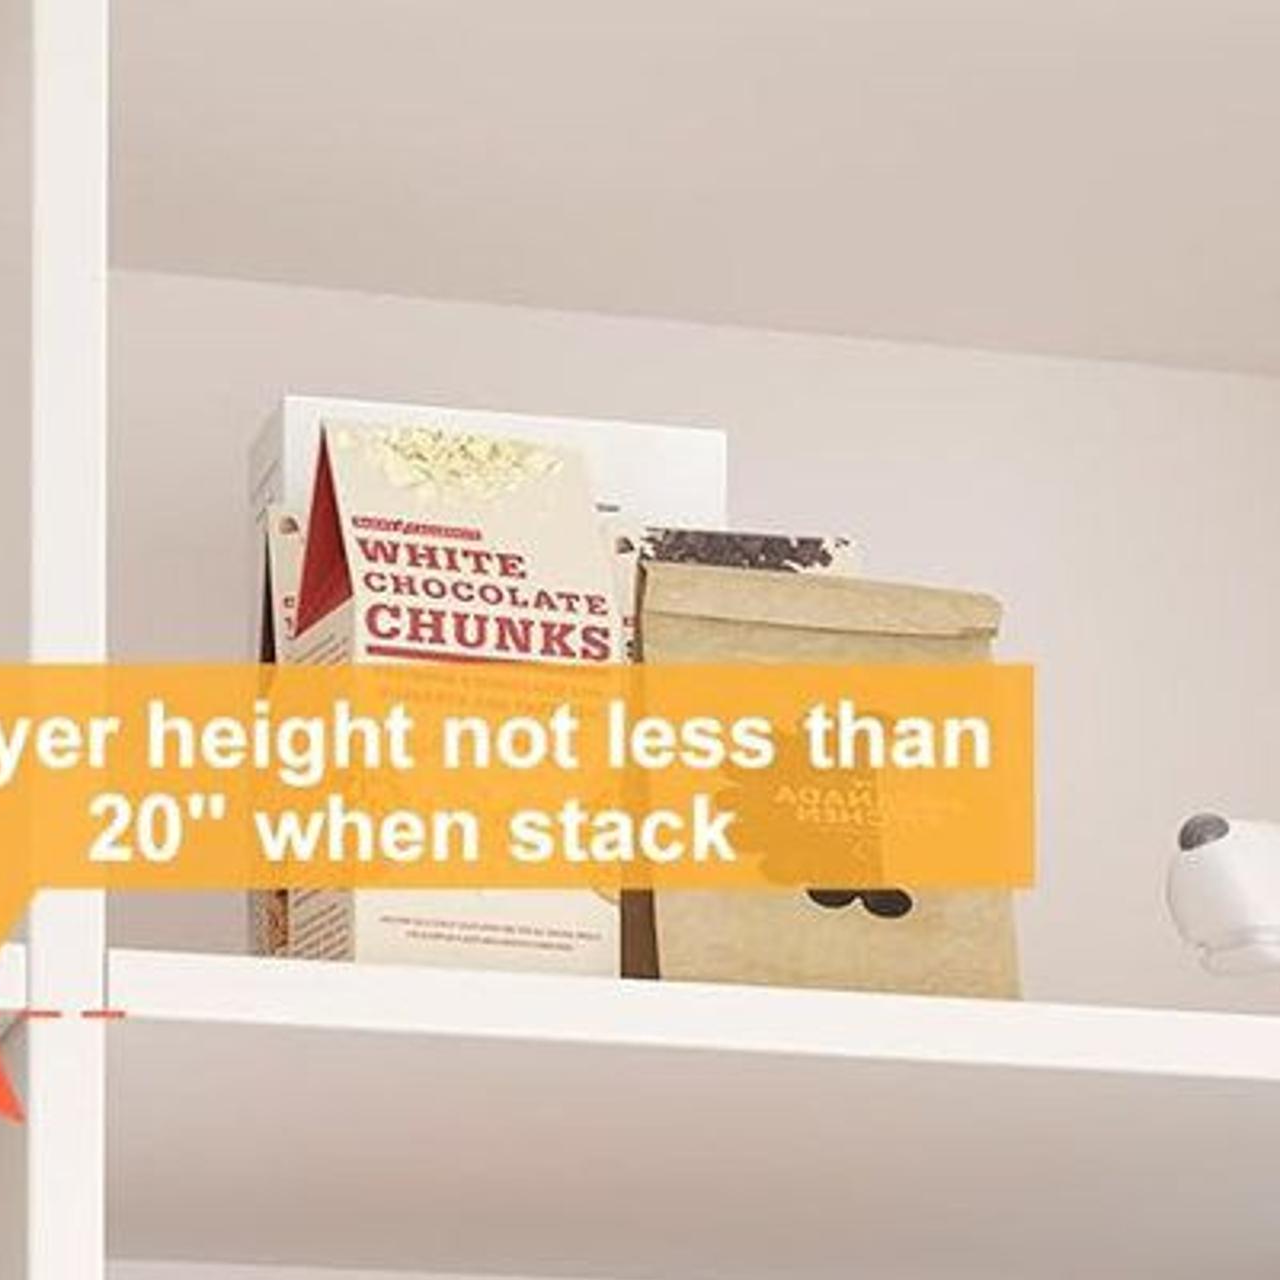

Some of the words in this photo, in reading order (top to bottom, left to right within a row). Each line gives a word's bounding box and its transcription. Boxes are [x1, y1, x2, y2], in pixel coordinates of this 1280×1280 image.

[355, 537, 527, 580] WHITE
[363, 571, 609, 617] CHOCOLATE
[364, 603, 612, 662] CHUNKS
